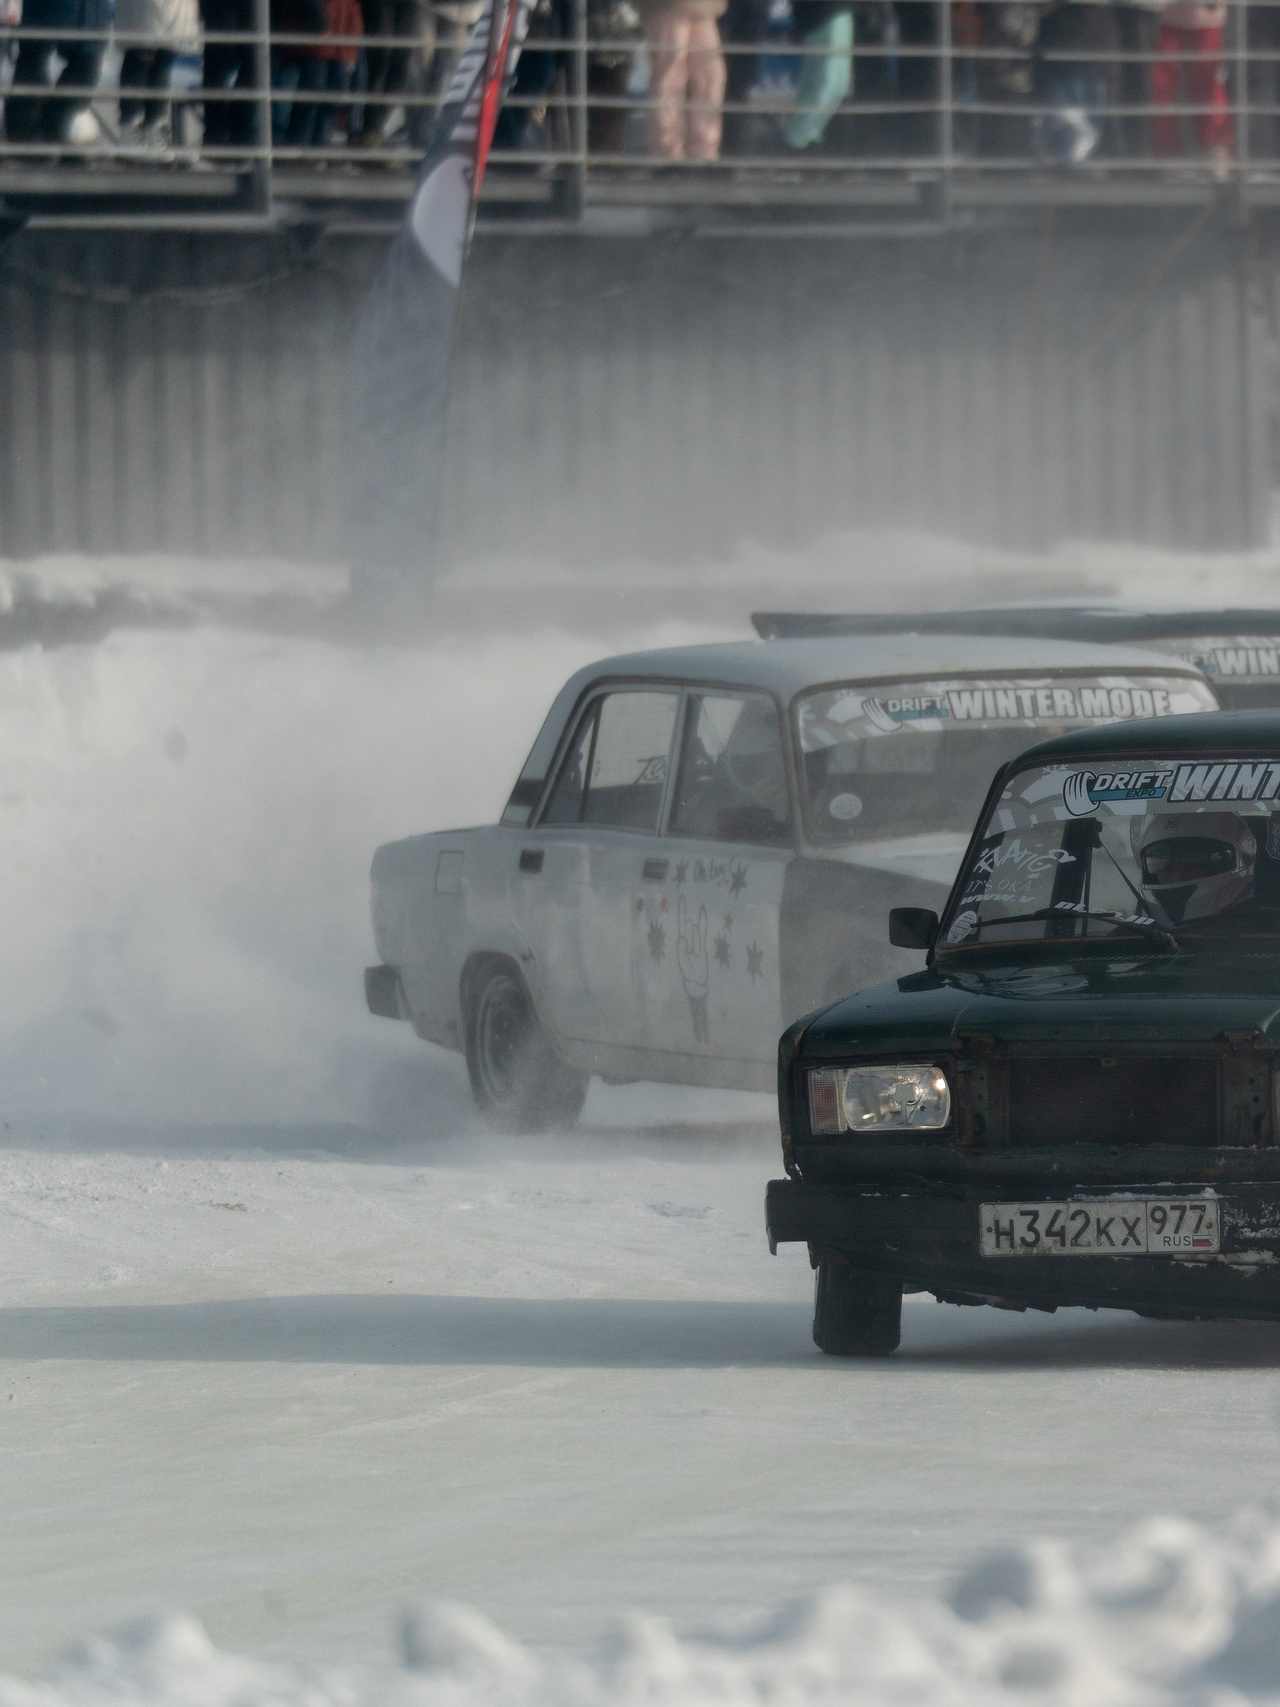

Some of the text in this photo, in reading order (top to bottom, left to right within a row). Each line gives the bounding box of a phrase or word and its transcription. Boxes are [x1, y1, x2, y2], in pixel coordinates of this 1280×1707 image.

[887, 695, 946, 713] DRIFT
[947, 688, 1170, 720] WINTER MODE
[1092, 771, 1174, 791] DRIFT
[1125, 788, 1158, 798] EXPO
[1150, 1204, 1208, 1236] 977
[1162, 1234, 1192, 1248] RUS
